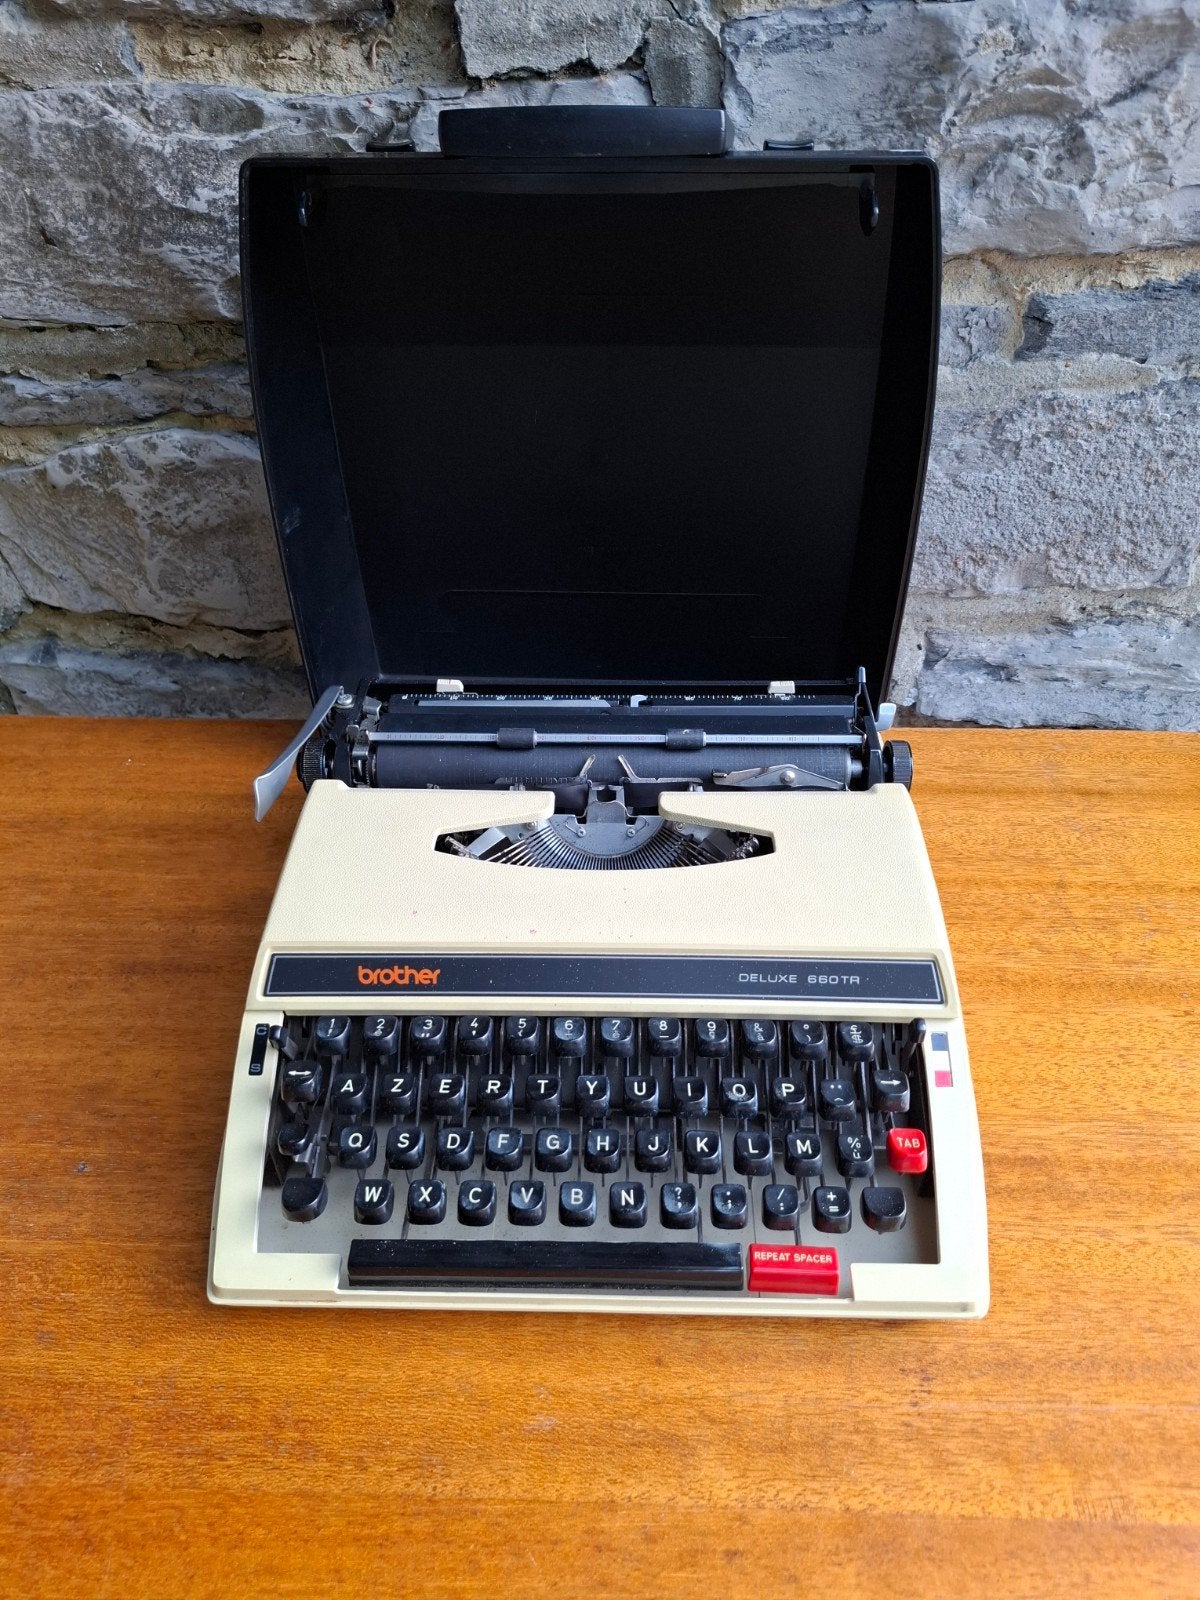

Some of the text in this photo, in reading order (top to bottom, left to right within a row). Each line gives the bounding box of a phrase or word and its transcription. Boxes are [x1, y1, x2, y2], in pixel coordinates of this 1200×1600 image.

[357, 965, 441, 986] brother
[738, 973, 860, 985] DELUXE 660TR
[330, 1018, 336, 1029] 1
[376, 1018, 386, 1030] 2
[422, 1019, 433, 1030] 3
[470, 1017, 479, 1028] 4
[518, 1018, 527, 1029] 5
[564, 1019, 574, 1031] 6
[611, 1019, 621, 1031] 7
[658, 1019, 668, 1031] 8
[706, 1020, 717, 1033] 9
[753, 1022, 764, 1033] &
[849, 1024, 862, 1035] £
[256, 1026, 267, 1036] C
[250, 1064, 261, 1072] S
[340, 1079, 354, 1093] A
[390, 1078, 405, 1093] Z
[438, 1078, 453, 1094] E
[485, 1079, 501, 1094] R
[536, 1079, 549, 1094] T
[586, 1080, 598, 1095] Y
[633, 1081, 647, 1096] U
[687, 1082, 692, 1097] I
[735, 1083, 747, 1097] O
[781, 1082, 795, 1097] P
[348, 1132, 363, 1148] Q
[397, 1132, 410, 1149] S
[446, 1133, 461, 1149] D
[497, 1133, 510, 1149] F
[546, 1134, 560, 1150] G
[596, 1135, 610, 1151] H
[647, 1135, 659, 1152] J
[696, 1136, 709, 1153] K
[747, 1137, 759, 1154] L
[796, 1139, 813, 1155] M
[896, 1136, 921, 1149] TAB
[364, 1185, 383, 1203] W
[418, 1186, 433, 1203] X
[468, 1186, 482, 1204] C
[518, 1186, 534, 1204] V
[570, 1188, 584, 1205] B
[620, 1189, 635, 1206] N
[754, 1251, 833, 1264] REPEAT SPACER
